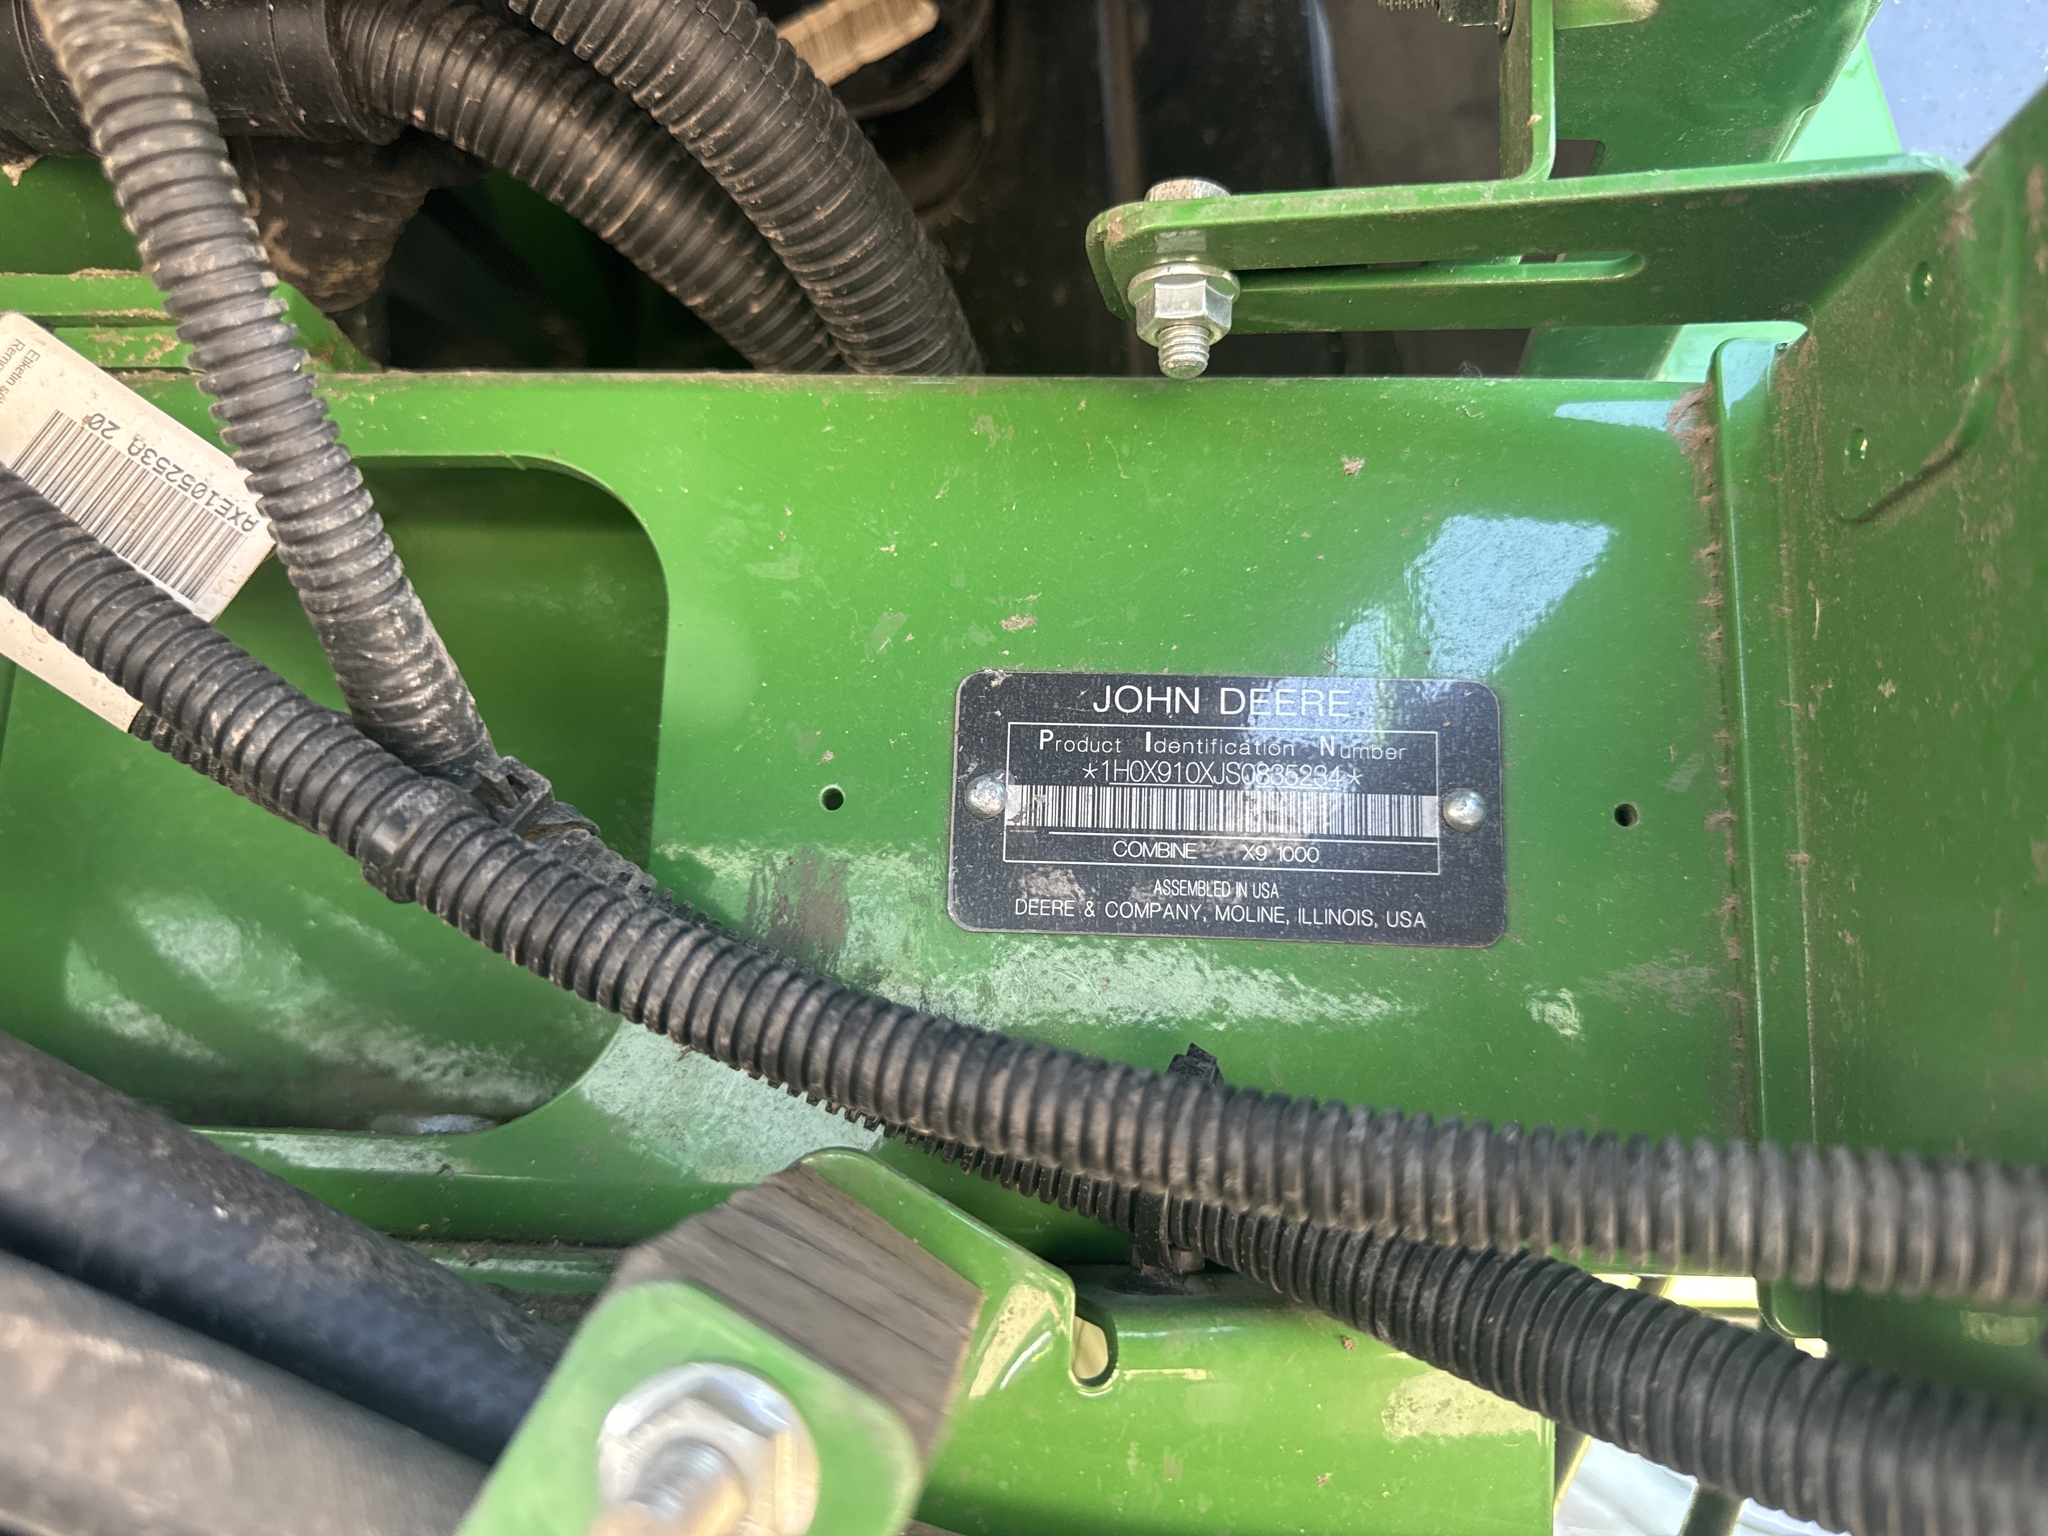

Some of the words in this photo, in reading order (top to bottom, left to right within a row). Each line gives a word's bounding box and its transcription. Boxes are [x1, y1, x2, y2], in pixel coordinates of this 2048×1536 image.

[6, 349, 41, 386] Etiketin
[88, 413, 121, 439] 20
[127, 438, 260, 532] AXE105253A
[1093, 685, 1200, 714] JOHN
[1220, 687, 1351, 718] DEERE
[1039, 729, 1122, 753] Product
[1145, 731, 1295, 756] Identification
[1320, 735, 1408, 760] Number
[1113, 840, 1198, 860] COMBINE
[1242, 844, 1267, 861] X9
[1277, 846, 1319, 863] 1000
[1154, 879, 1230, 897] ASSEMBLED
[1235, 881, 1248, 898] IN
[1252, 882, 1279, 899] USA
[1015, 899, 1075, 917] DEERE
[1084, 901, 1096, 918] &
[1105, 901, 1207, 922] COMPANY,
[1215, 905, 1290, 925] MOLINE,
[1298, 908, 1378, 928] ILLINOIS,
[1386, 911, 1426, 928] USA
